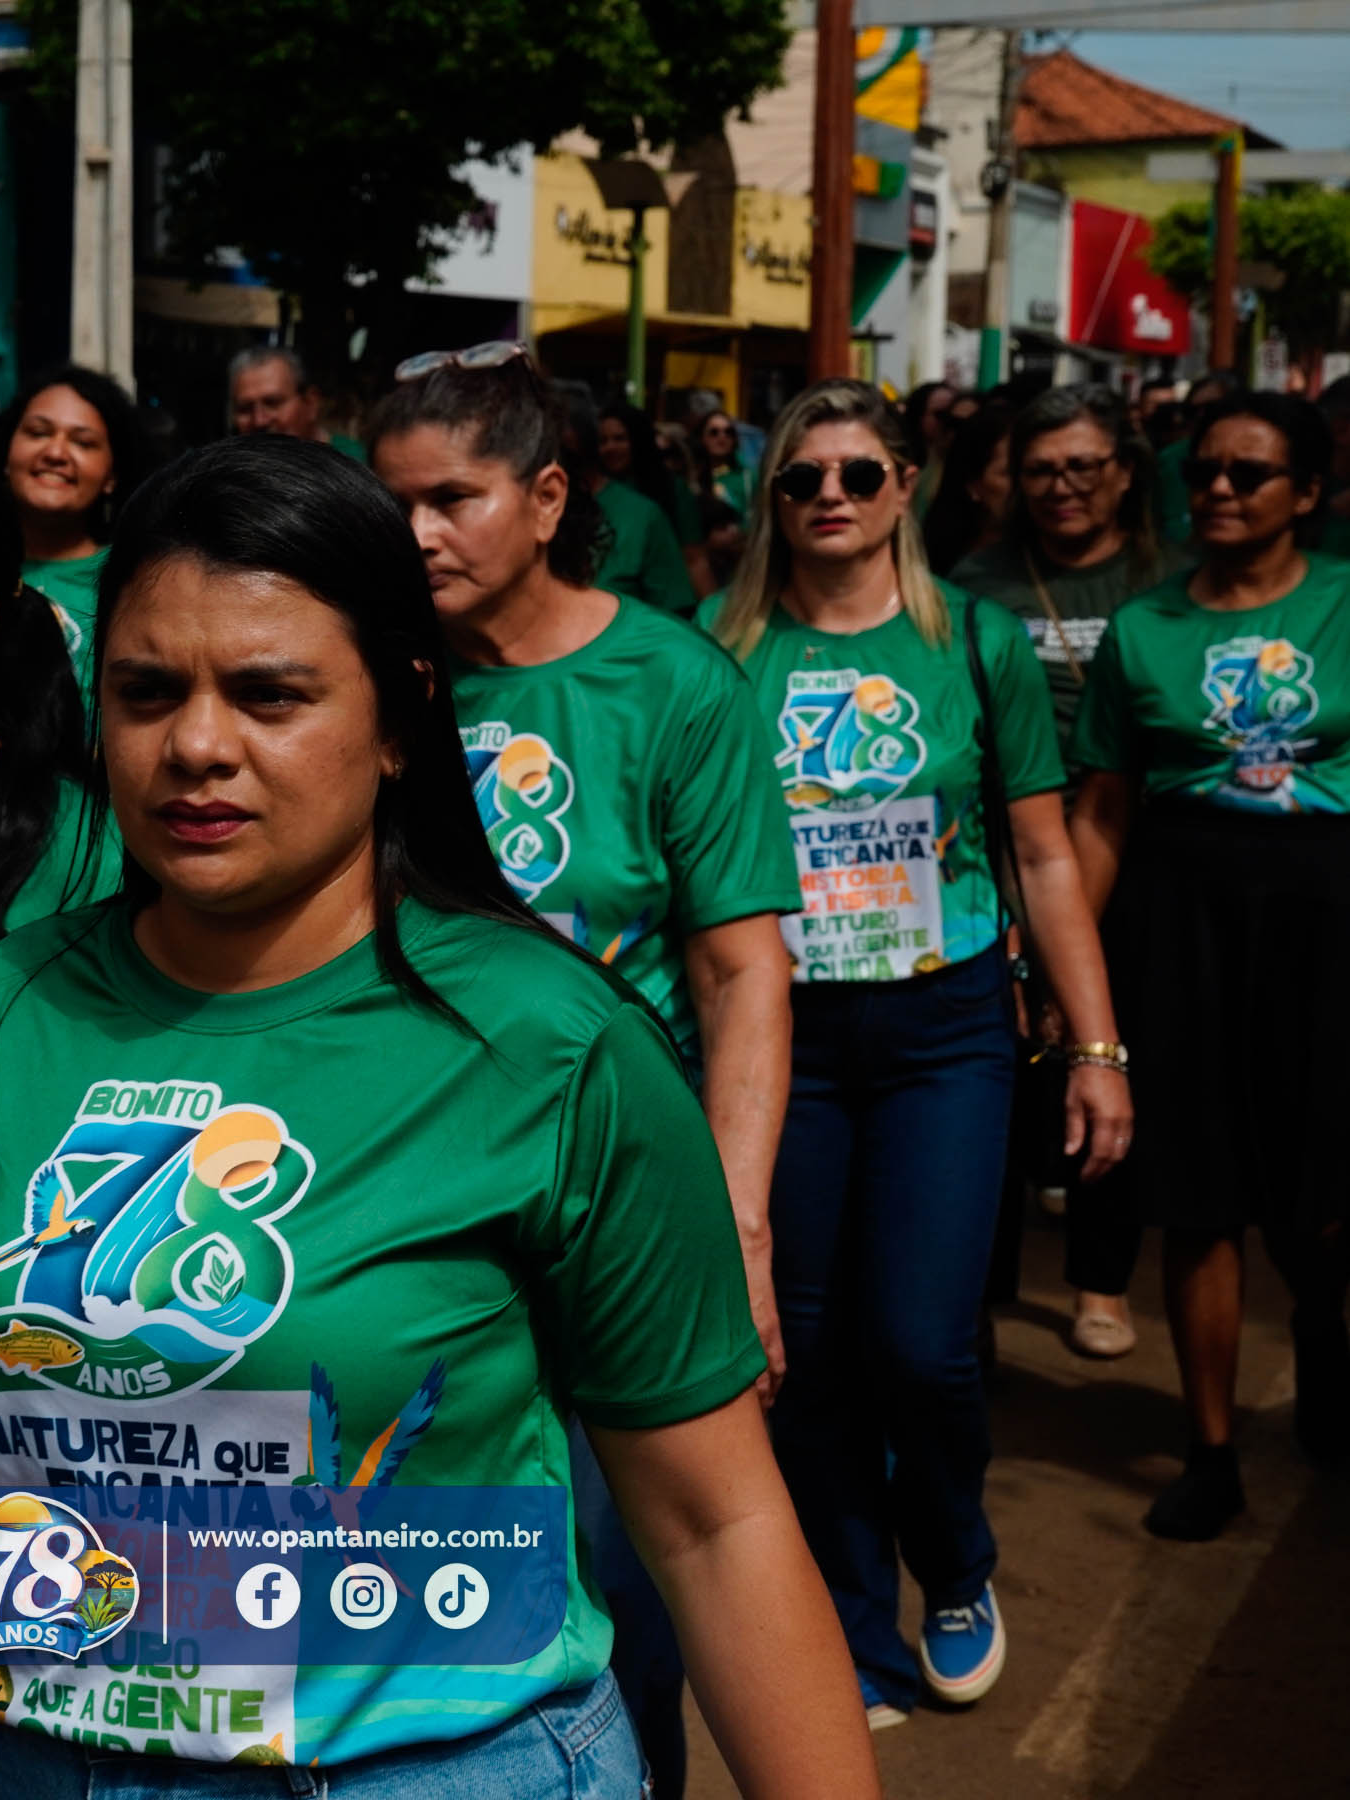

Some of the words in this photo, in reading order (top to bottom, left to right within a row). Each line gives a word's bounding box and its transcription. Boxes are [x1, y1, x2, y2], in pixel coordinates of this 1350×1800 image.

[784, 674, 928, 784] 78
[793, 820, 889, 845] TUREZA
[802, 911, 899, 937] FUTURO
[81, 1085, 217, 1121] BONITO
[16, 1103, 318, 1345] 78
[76, 1360, 173, 1396] ANOS
[215, 1441, 290, 1479] QUE
[23, 1678, 76, 1715] QUE
[80, 1689, 95, 1721] A
[103, 1680, 265, 1735] GENTE
